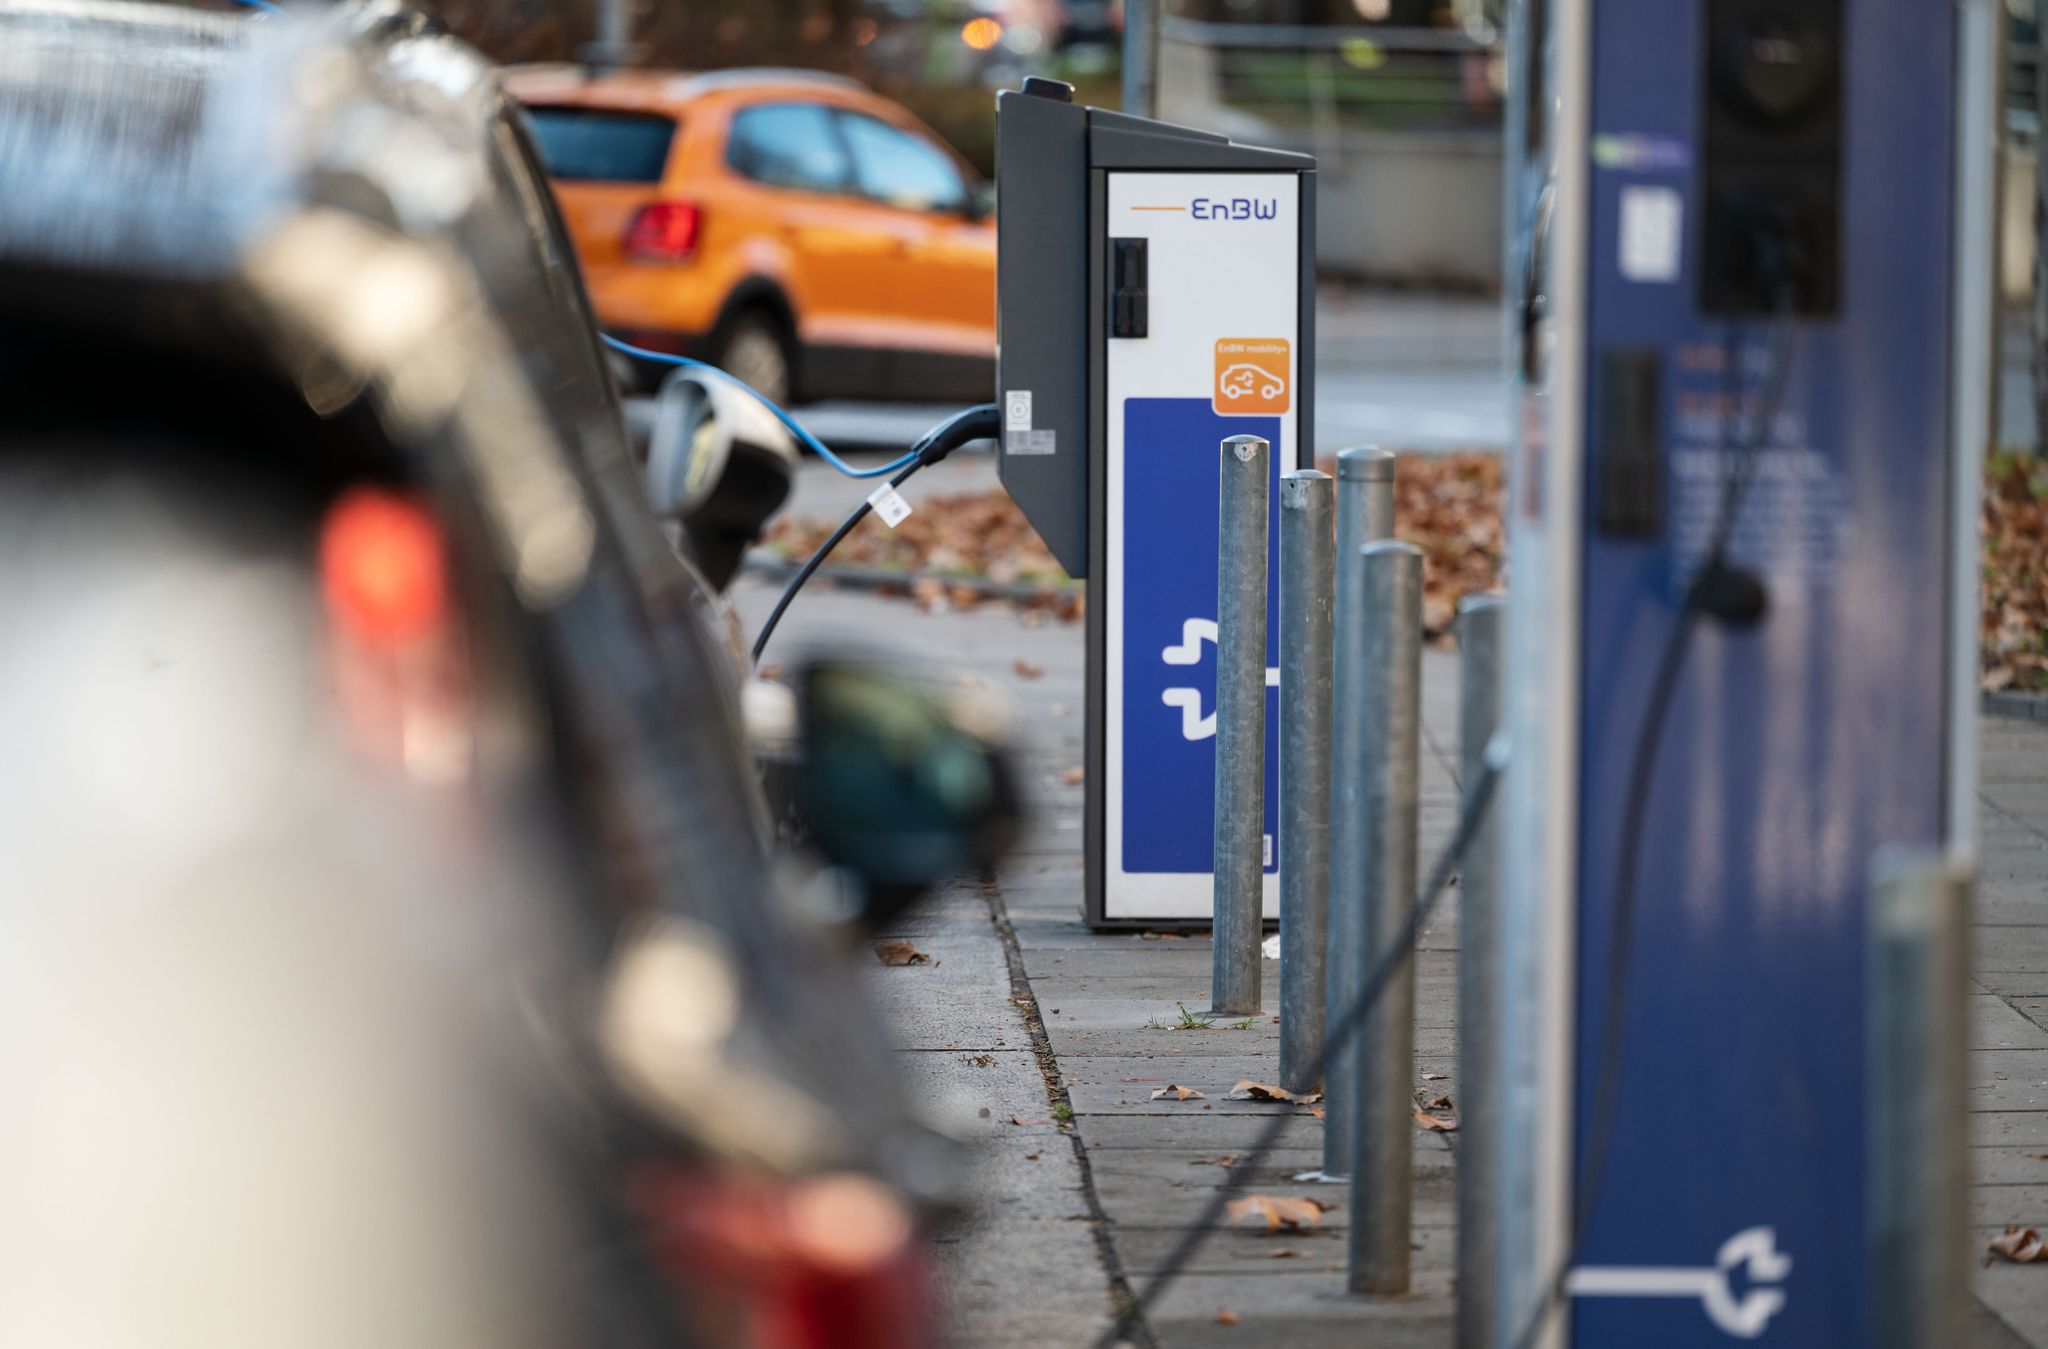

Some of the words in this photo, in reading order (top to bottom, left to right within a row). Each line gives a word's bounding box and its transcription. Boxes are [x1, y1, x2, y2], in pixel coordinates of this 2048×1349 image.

[1191, 198, 1277, 220] EnBW
[1217, 343, 1245, 353] EnBW
[1247, 343, 1287, 355] mobility+
